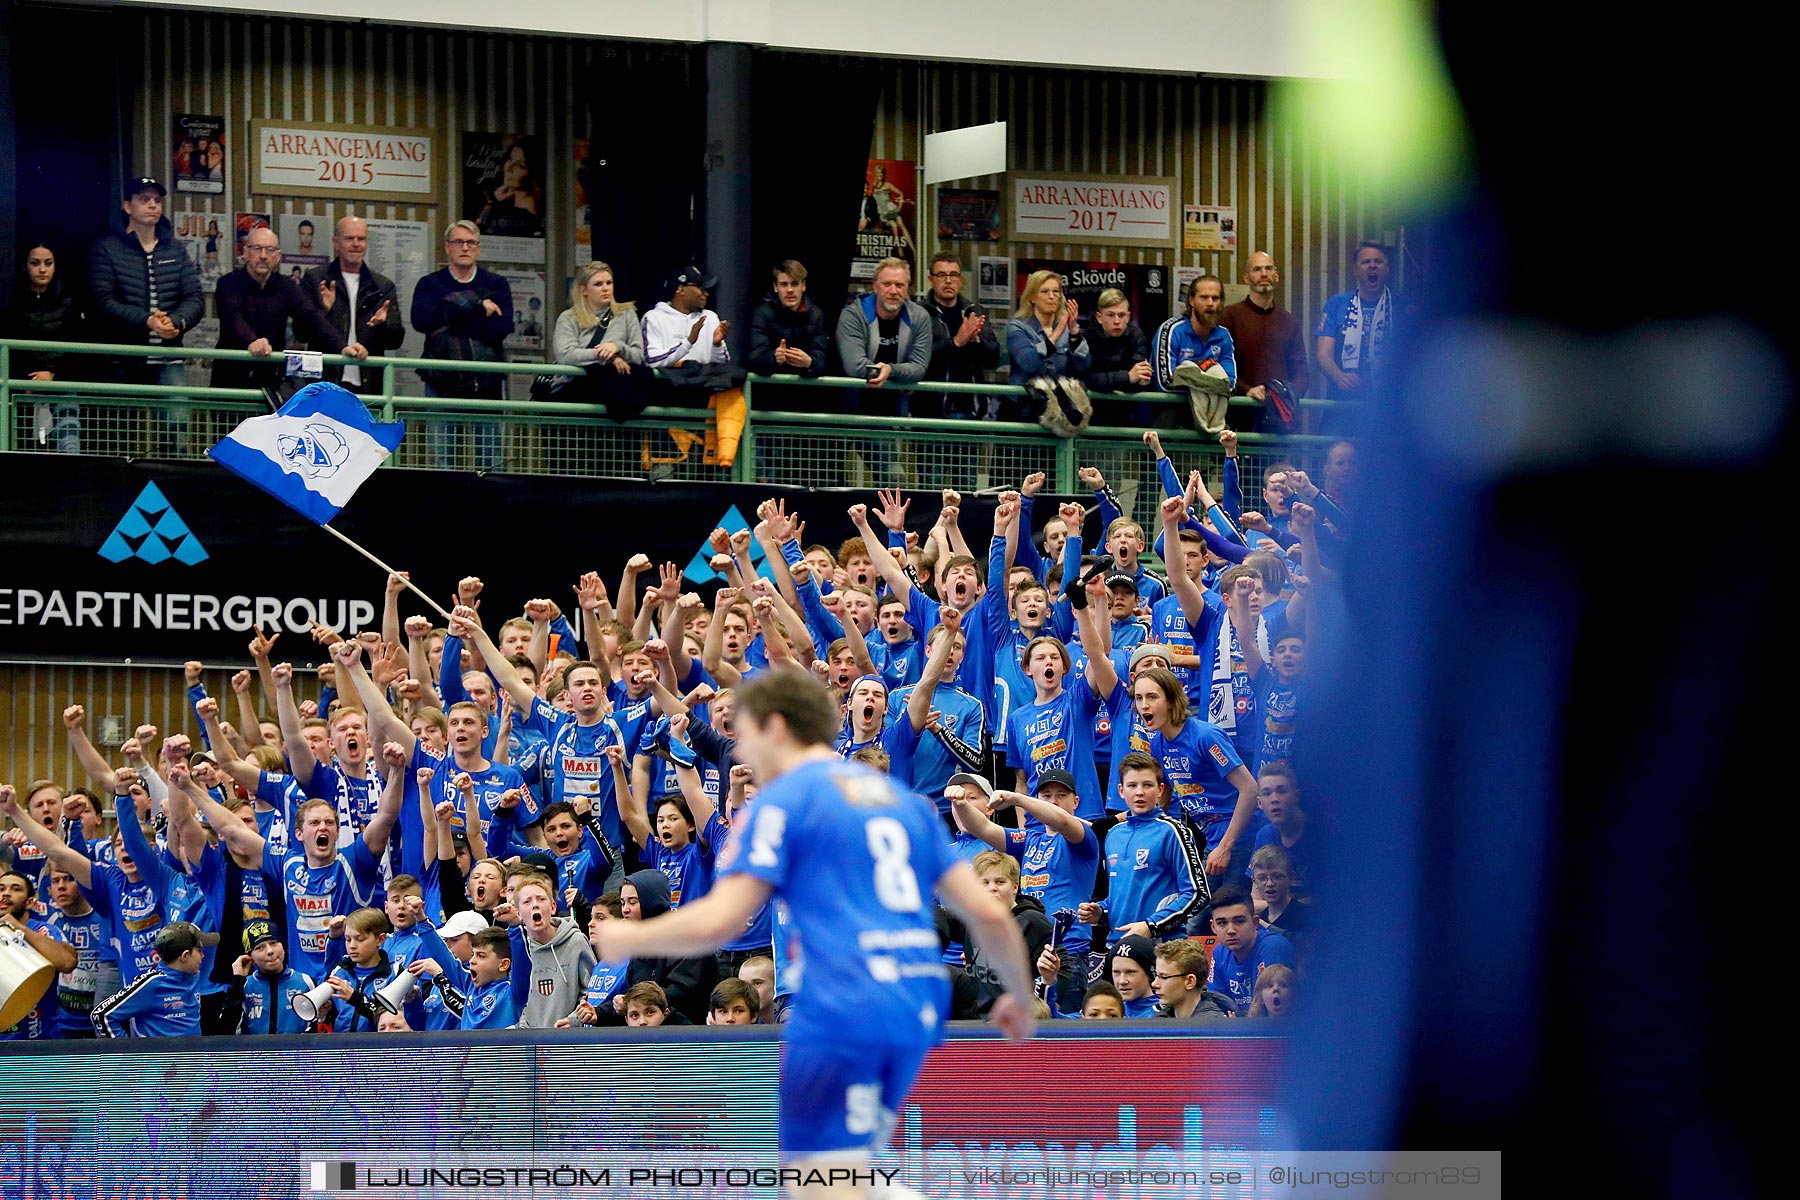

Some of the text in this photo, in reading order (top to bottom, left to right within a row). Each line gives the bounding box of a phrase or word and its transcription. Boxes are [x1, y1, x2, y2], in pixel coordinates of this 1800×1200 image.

[265, 134, 426, 162] ARRANGEMANG
[318, 160, 373, 185] 2015
[1021, 185, 1166, 210] ARRANGEMANG
[1068, 209, 1118, 231] 2017
[860, 245, 894, 258] NIGHT
[1072, 268, 1126, 286] Skövde
[1165, 614, 1172, 628] 9
[1024, 722, 1036, 737] 14
[1211, 744, 1228, 765] MAXI
[564, 759, 598, 773] MAXI
[520, 782, 537, 814] MAXI
[864, 816, 923, 914] 8
[295, 865, 310, 887] 68
[295, 898, 329, 910] MAXI
